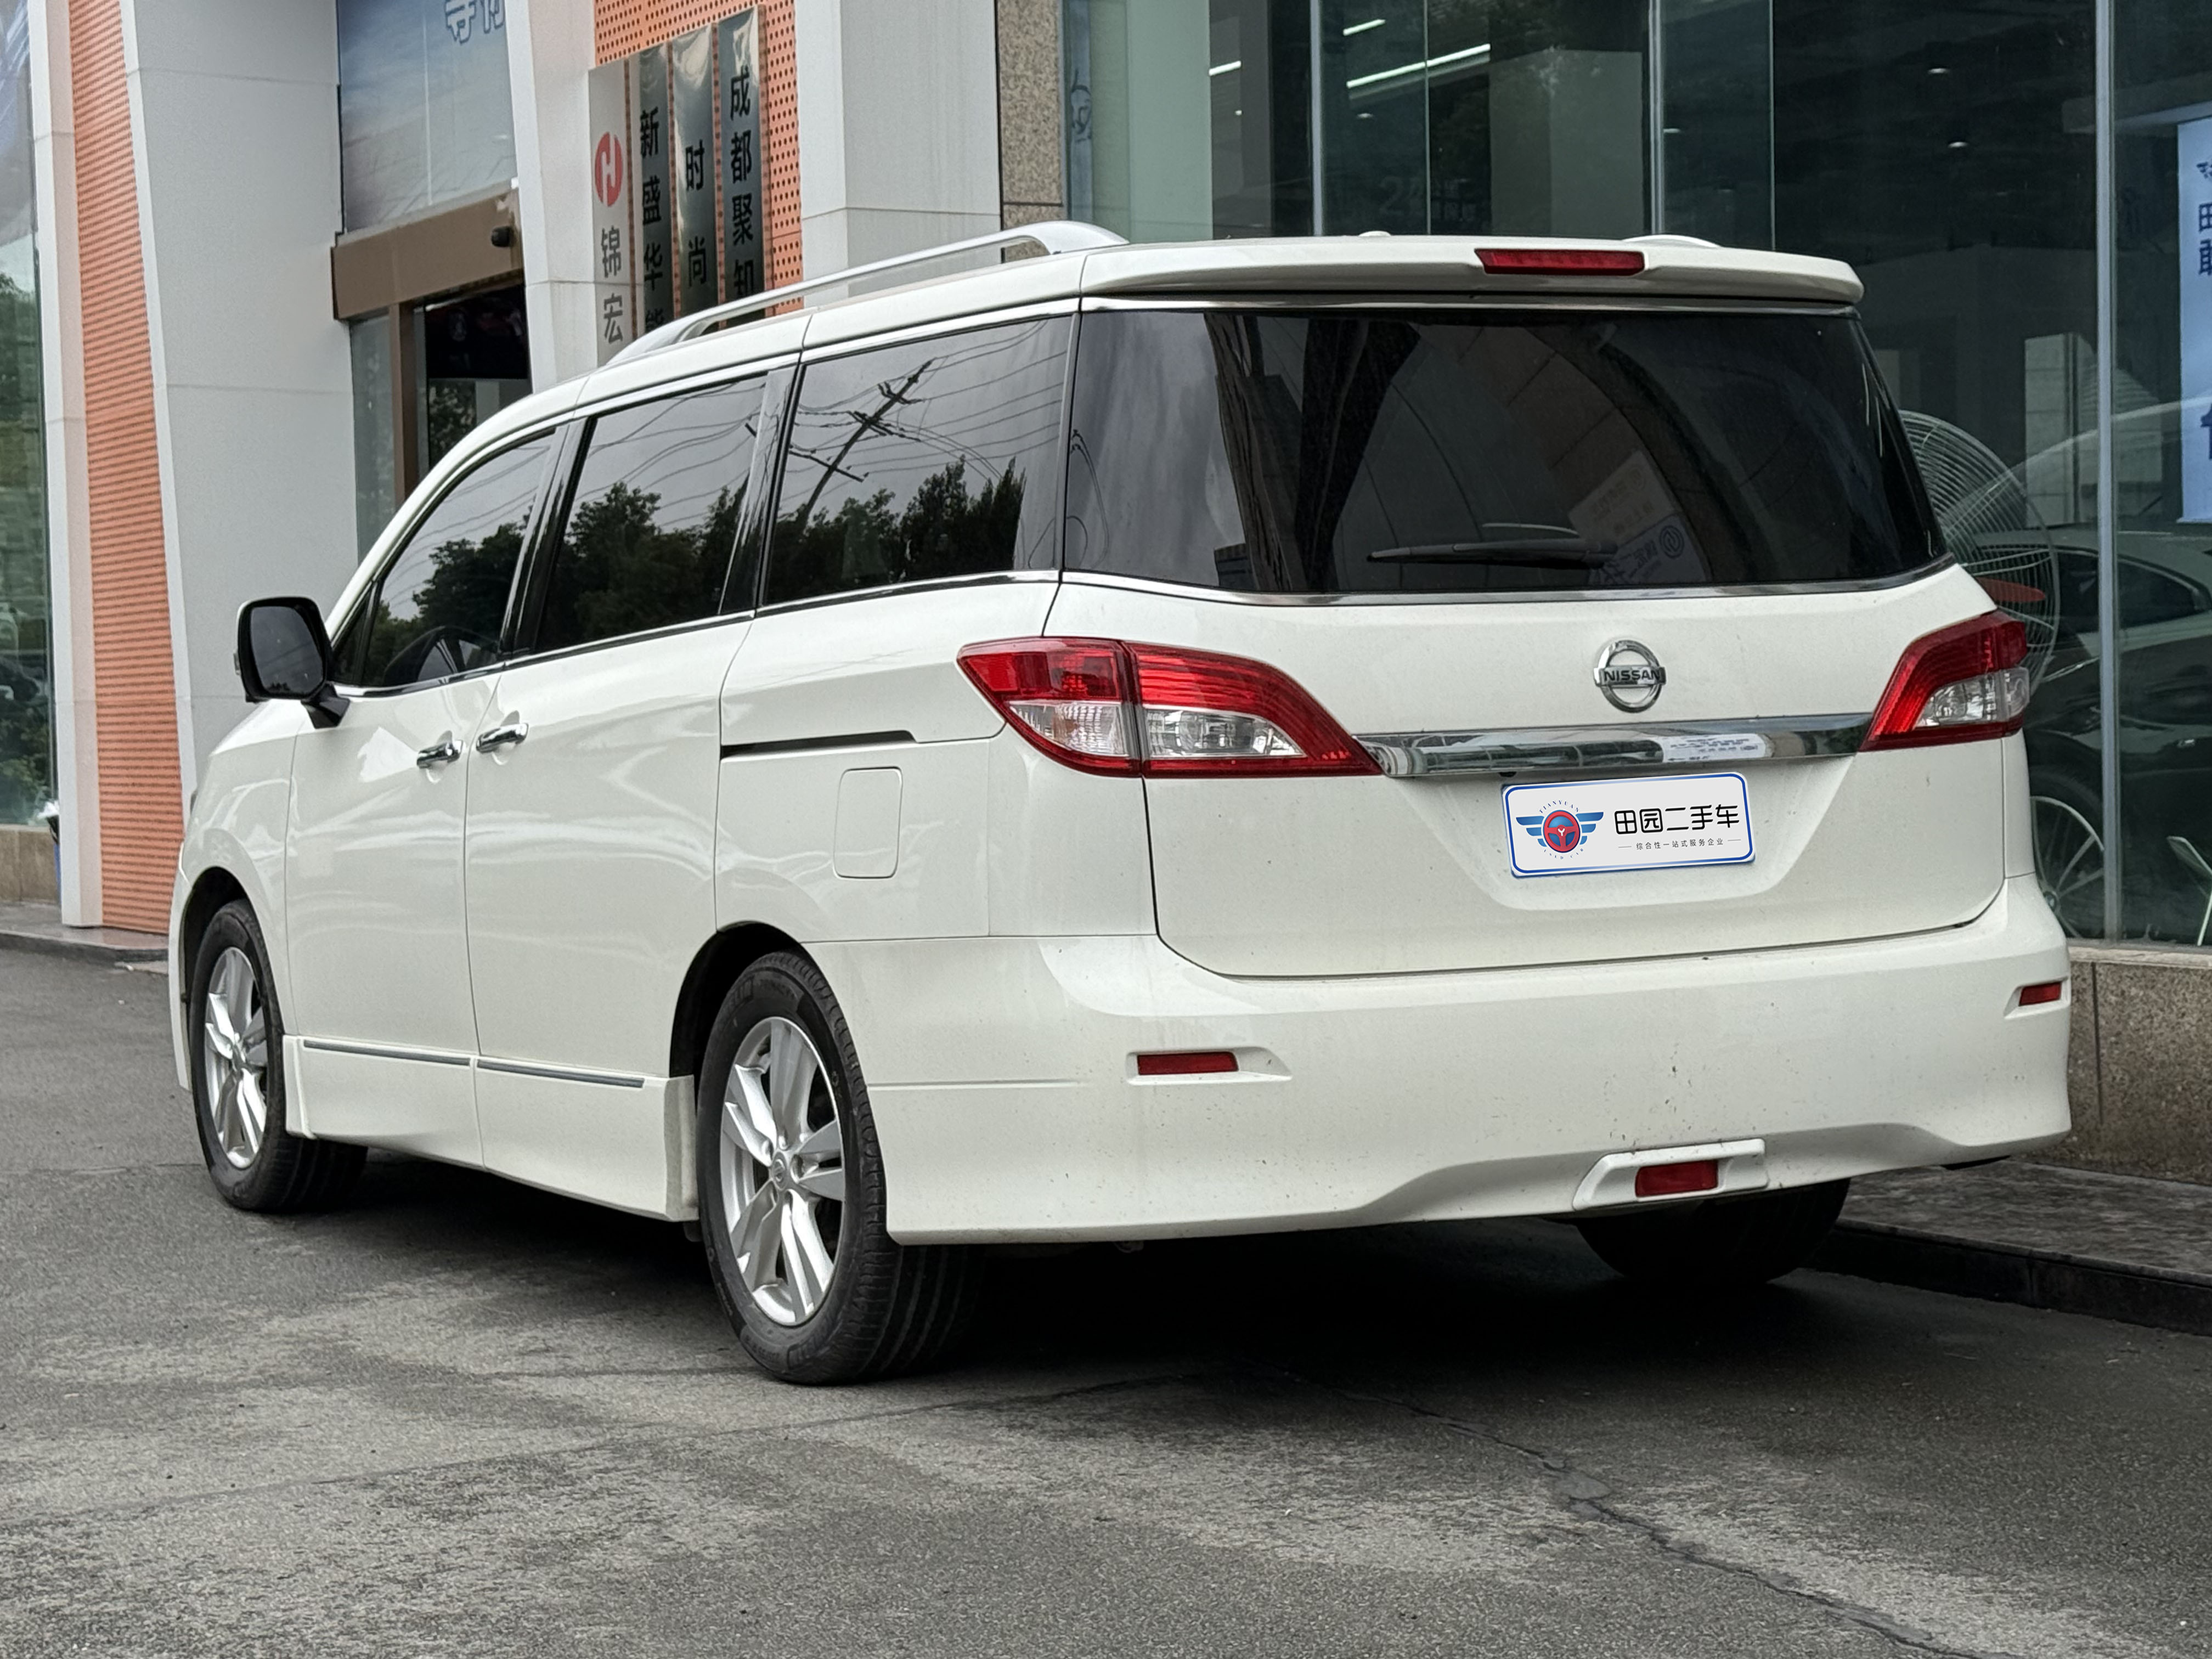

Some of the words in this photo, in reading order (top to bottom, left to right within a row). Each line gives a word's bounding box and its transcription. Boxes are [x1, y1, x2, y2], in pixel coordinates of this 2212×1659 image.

[685, 139, 707, 287] 时尚
[601, 226, 623, 345] 锦宏
[1604, 669, 1660, 682] NISSAN
[1614, 804, 1740, 834] 田园二手车
[1636, 838, 1724, 850] 综合性一站式服务企业
